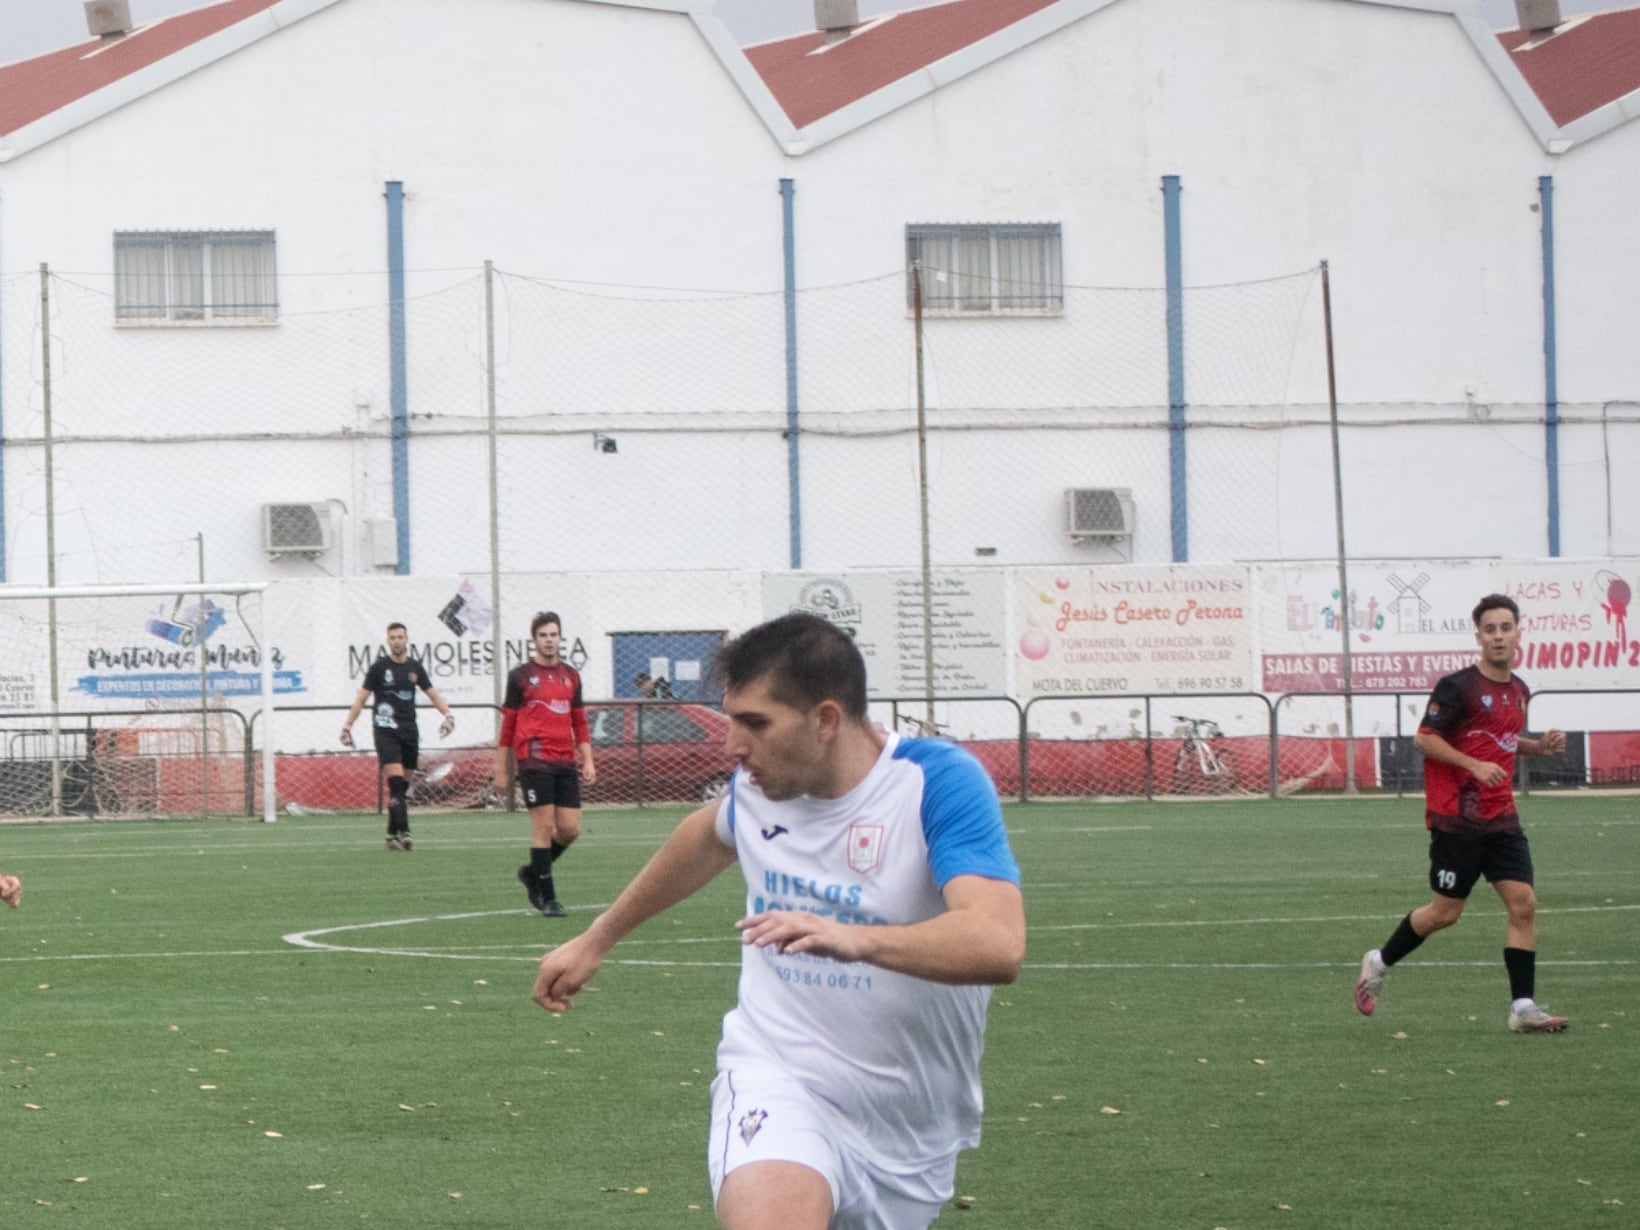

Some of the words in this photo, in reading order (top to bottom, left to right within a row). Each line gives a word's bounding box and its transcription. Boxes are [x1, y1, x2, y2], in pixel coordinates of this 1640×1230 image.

[1504, 581, 1562, 602] LACAS
[1571, 580, 1584, 599] Y
[1054, 600, 1109, 632] Jesús
[1113, 599, 1171, 625] Casero
[1175, 598, 1244, 626] Perona
[1422, 619, 1434, 632] EL
[1518, 613, 1593, 634] INTURAS
[1211, 634, 1234, 648] GAS
[348, 641, 494, 666] MAMOLES
[1198, 649, 1233, 662] SOLAR
[1510, 640, 1621, 670] DIMOPIN
[1265, 656, 1314, 676] SALAS
[1318, 655, 1338, 675] DE
[1345, 654, 1402, 674] IESTAS
[1406, 654, 1418, 672] Y
[1031, 678, 1061, 692] MOTA
[1064, 677, 1083, 691] DEL
[1085, 677, 1129, 691] CUERVO
[1177, 676, 1198, 689] 696
[1198, 676, 1212, 689] 90
[527, 788, 537, 803] 5
[764, 870, 863, 908] HIELOS
[1436, 869, 1457, 890] 19
[803, 971, 822, 986] 84
[827, 973, 849, 989] 06
[854, 975, 873, 990] 71
